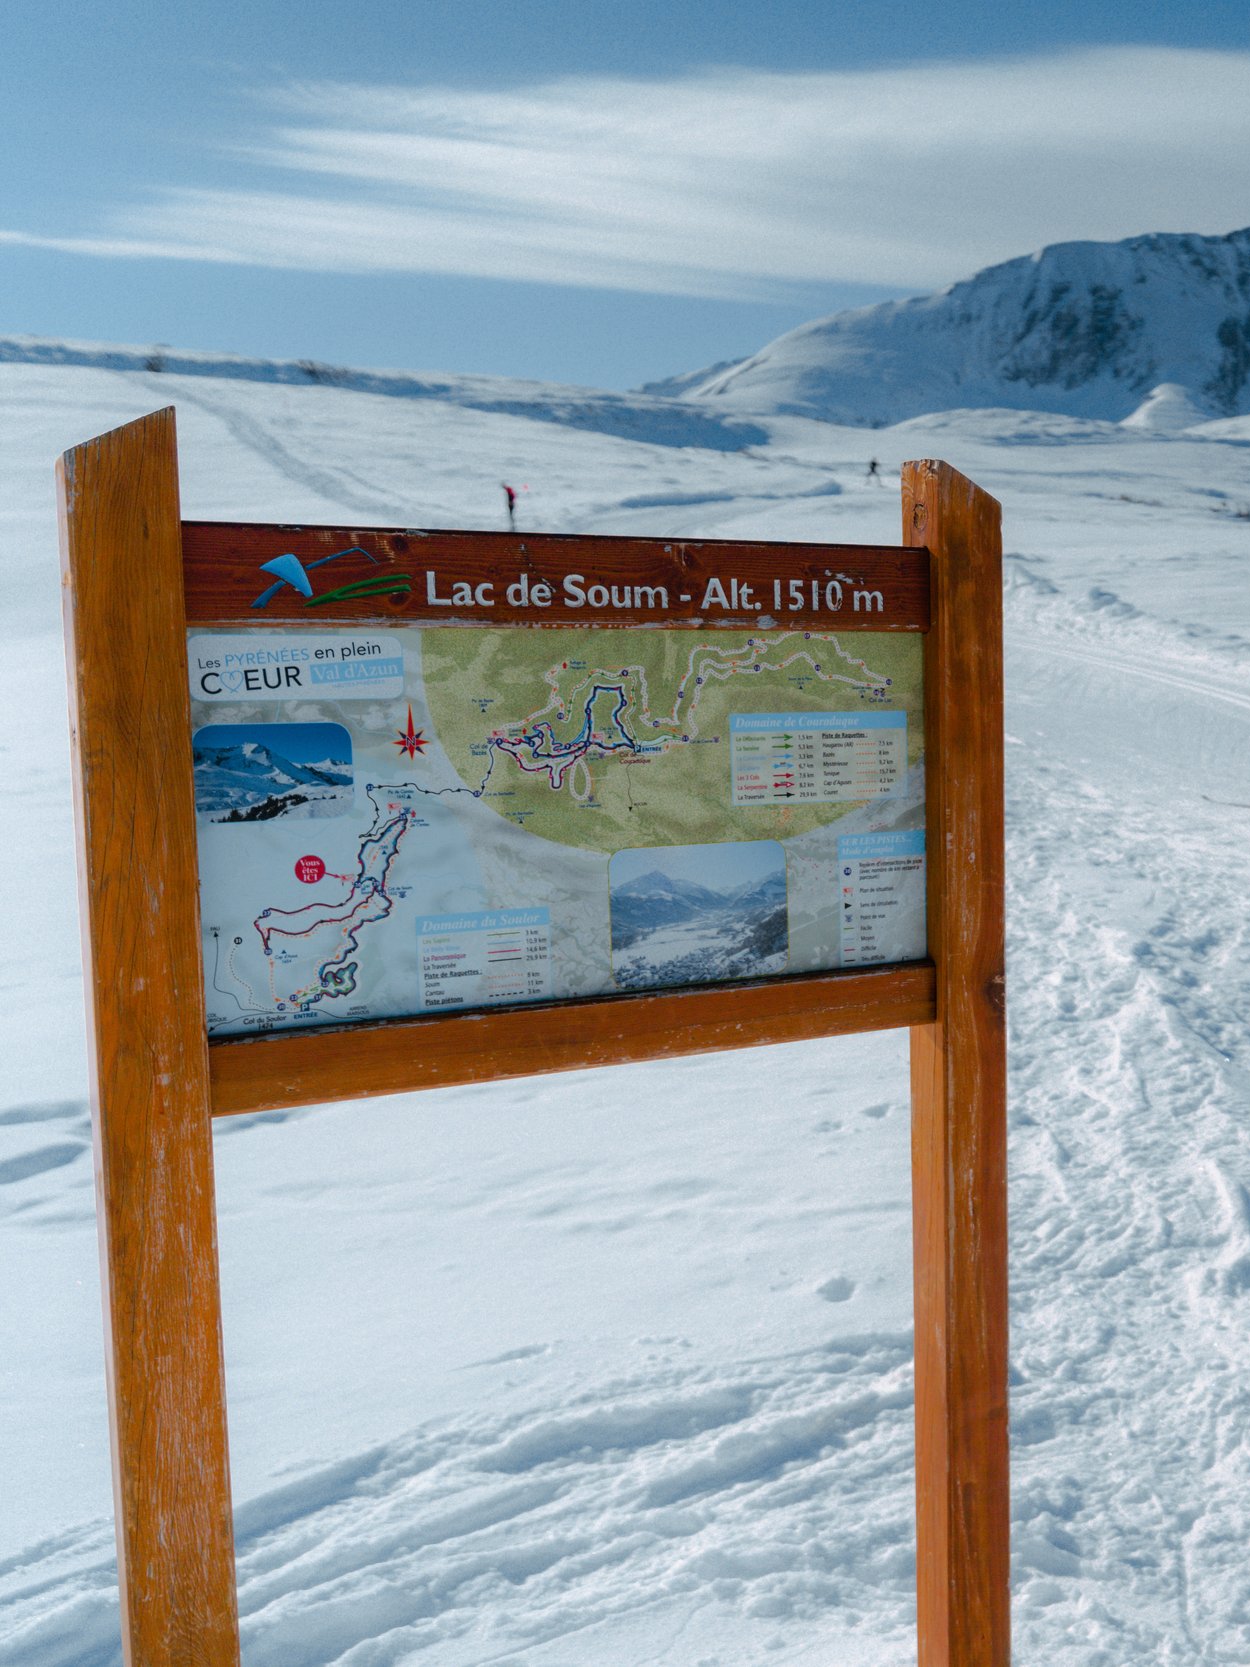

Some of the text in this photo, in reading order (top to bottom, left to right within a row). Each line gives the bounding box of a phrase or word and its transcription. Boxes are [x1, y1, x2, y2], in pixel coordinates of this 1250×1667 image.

[426, 571, 494, 606] Lac
[506, 573, 551, 607] de
[564, 574, 669, 609] Soum
[701, 577, 762, 610] Alt.
[773, 580, 843, 611] 1510
[854, 589, 883, 612] m
[198, 642, 381, 669] Les PYRÉNÉES en plein
[314, 662, 399, 681] Val d'Azun
[736, 717, 781, 728] Domaine
[784, 717, 796, 727] de
[300, 859, 320, 867] Vous
[422, 914, 540, 932] Domaine du Soulor
[431, 962, 456, 970] Traversée
[450, 969, 478, 977] Raquettes
[266, 1015, 287, 1023] Soulor
